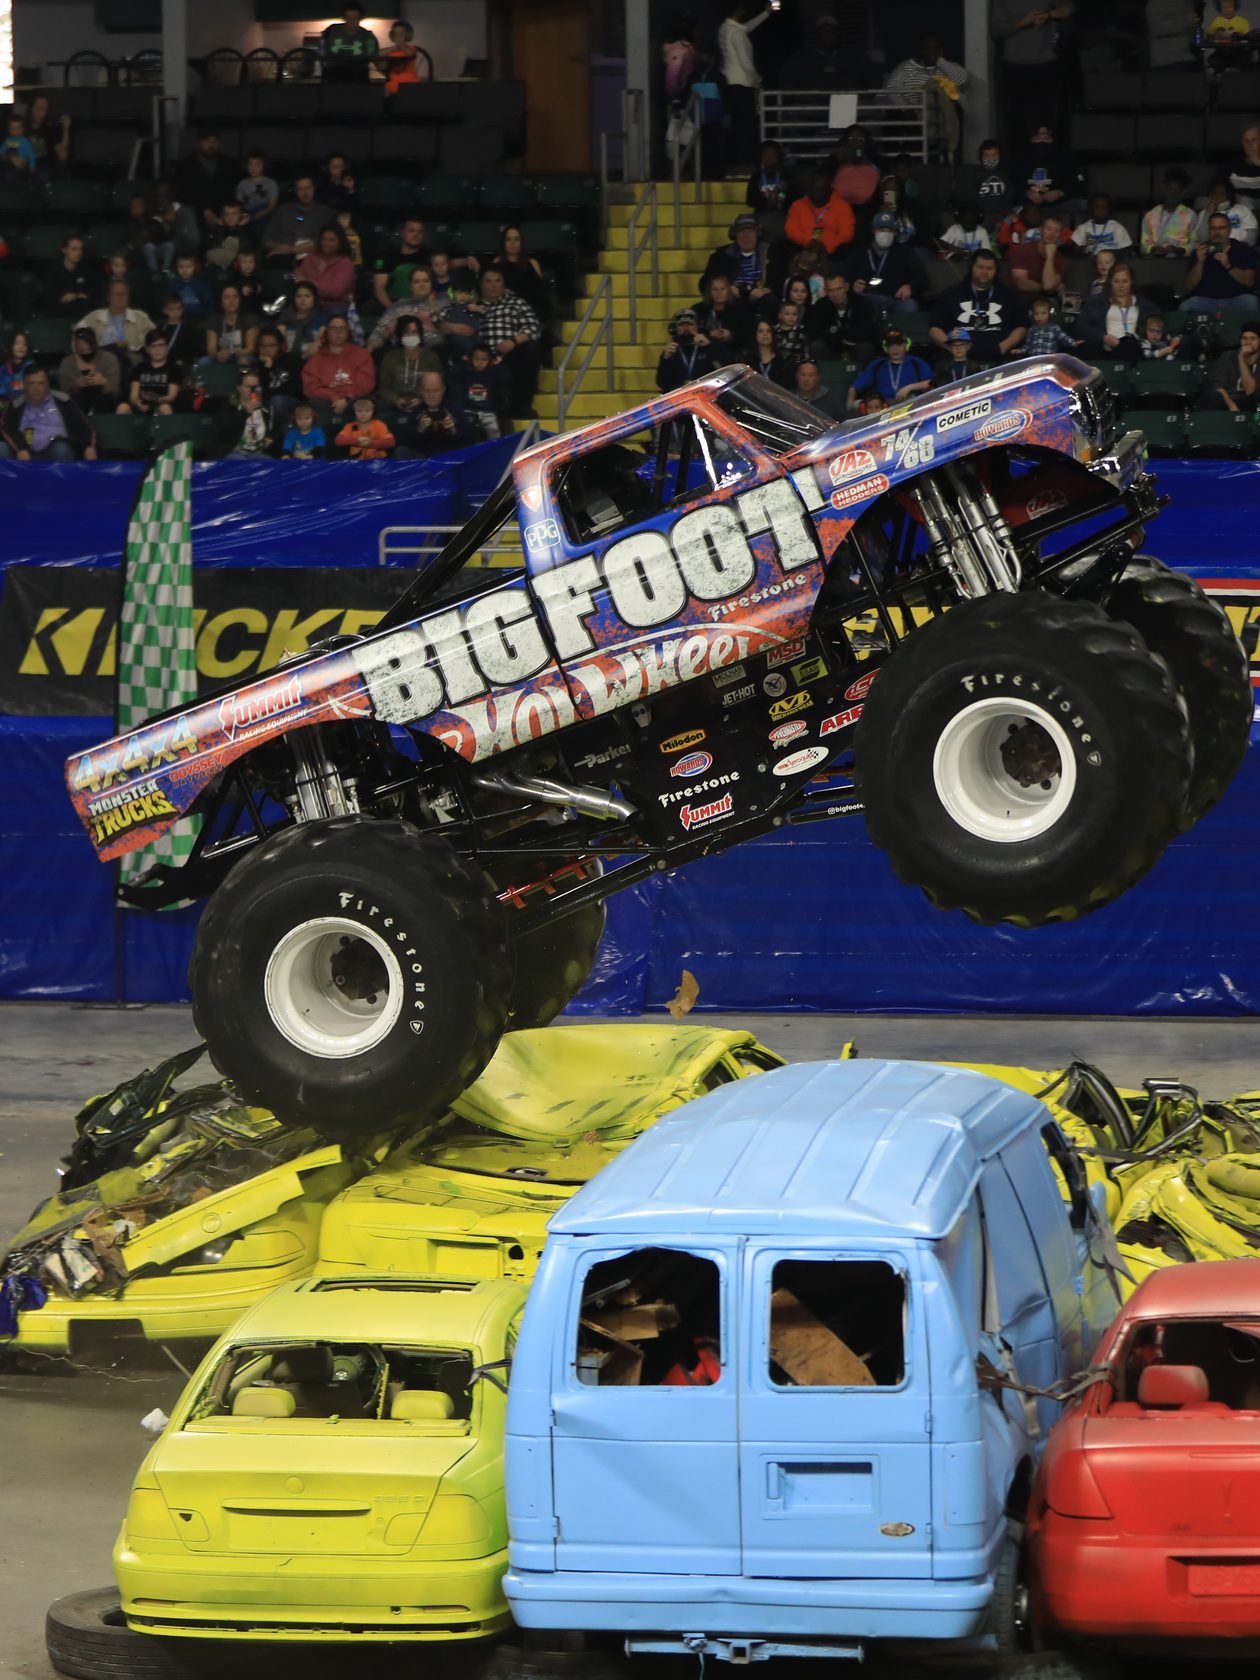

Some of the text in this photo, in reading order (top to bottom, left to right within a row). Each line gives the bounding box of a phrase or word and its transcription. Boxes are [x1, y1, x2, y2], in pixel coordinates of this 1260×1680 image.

[939, 402, 989, 428] COMETIC
[975, 415, 1022, 440] HOWARDS
[880, 419, 934, 470] 74/68
[831, 451, 872, 477] JAZ
[836, 477, 882, 501] HEDMAN
[838, 485, 885, 507] HEDDERS
[526, 524, 558, 549] PPG
[350, 466, 825, 725] BIGFOOT
[708, 573, 807, 621] Firestone
[768, 640, 804, 662] MSD
[714, 667, 743, 684] MOLNAR
[722, 684, 755, 705] JET-HOT
[960, 673, 1093, 744] Firestone
[239, 708, 309, 740] RACING EQUIPMENT
[662, 731, 703, 751] Milodon
[169, 752, 224, 782] ODYSSEY
[583, 743, 632, 768] Parker
[671, 757, 705, 776] HOWARDS
[88, 778, 160, 816] MONSTER
[658, 771, 740, 808] Firestone
[89, 790, 178, 844] TRUCKS
[692, 811, 735, 831] RACING EQUIPMENT
[338, 891, 426, 1012] Firestone
